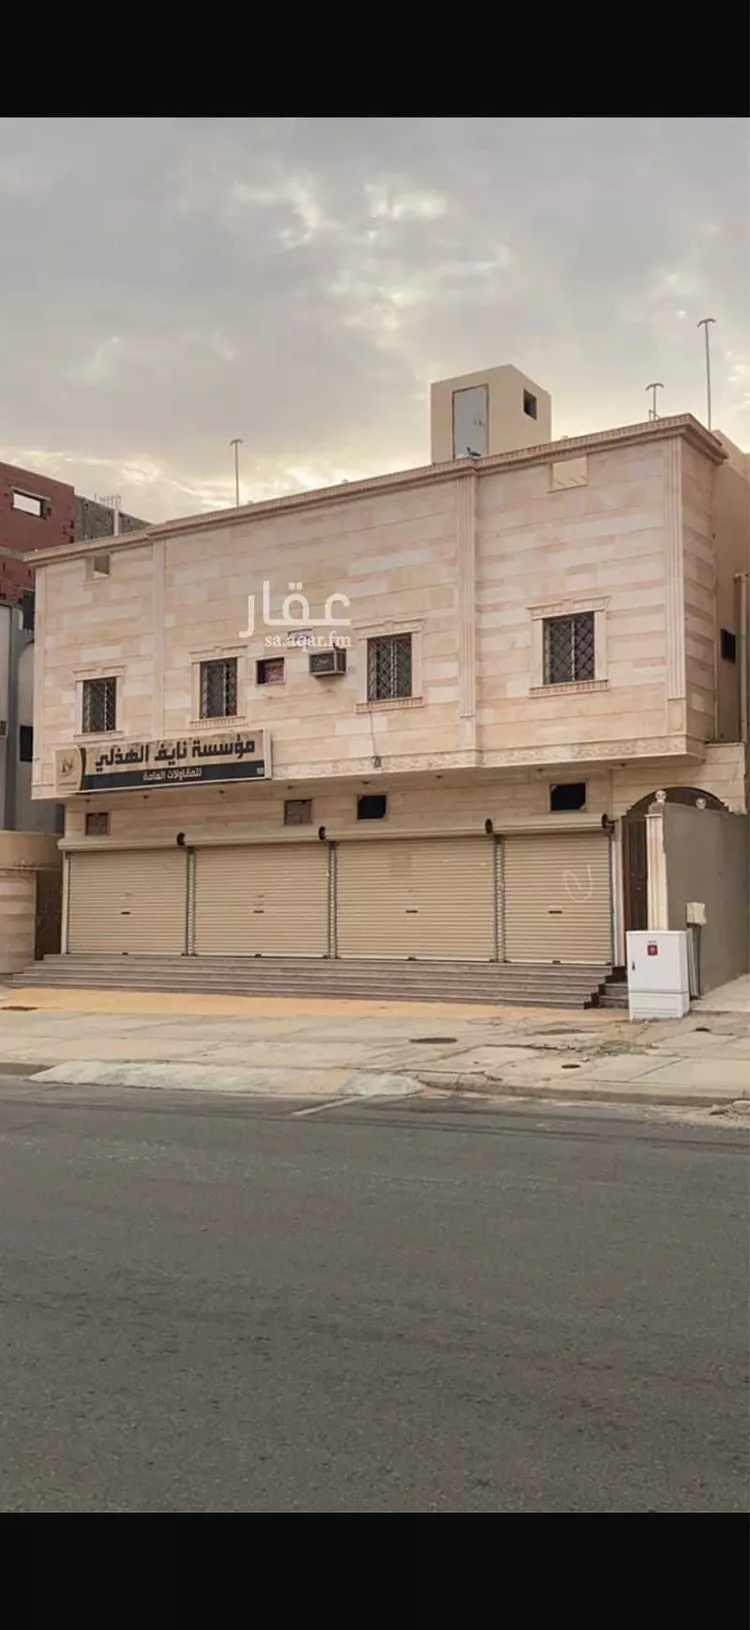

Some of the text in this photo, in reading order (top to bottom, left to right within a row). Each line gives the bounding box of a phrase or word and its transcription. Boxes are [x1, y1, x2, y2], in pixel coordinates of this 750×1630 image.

[95, 734, 255, 772] مؤسسة نايف الهذلي
